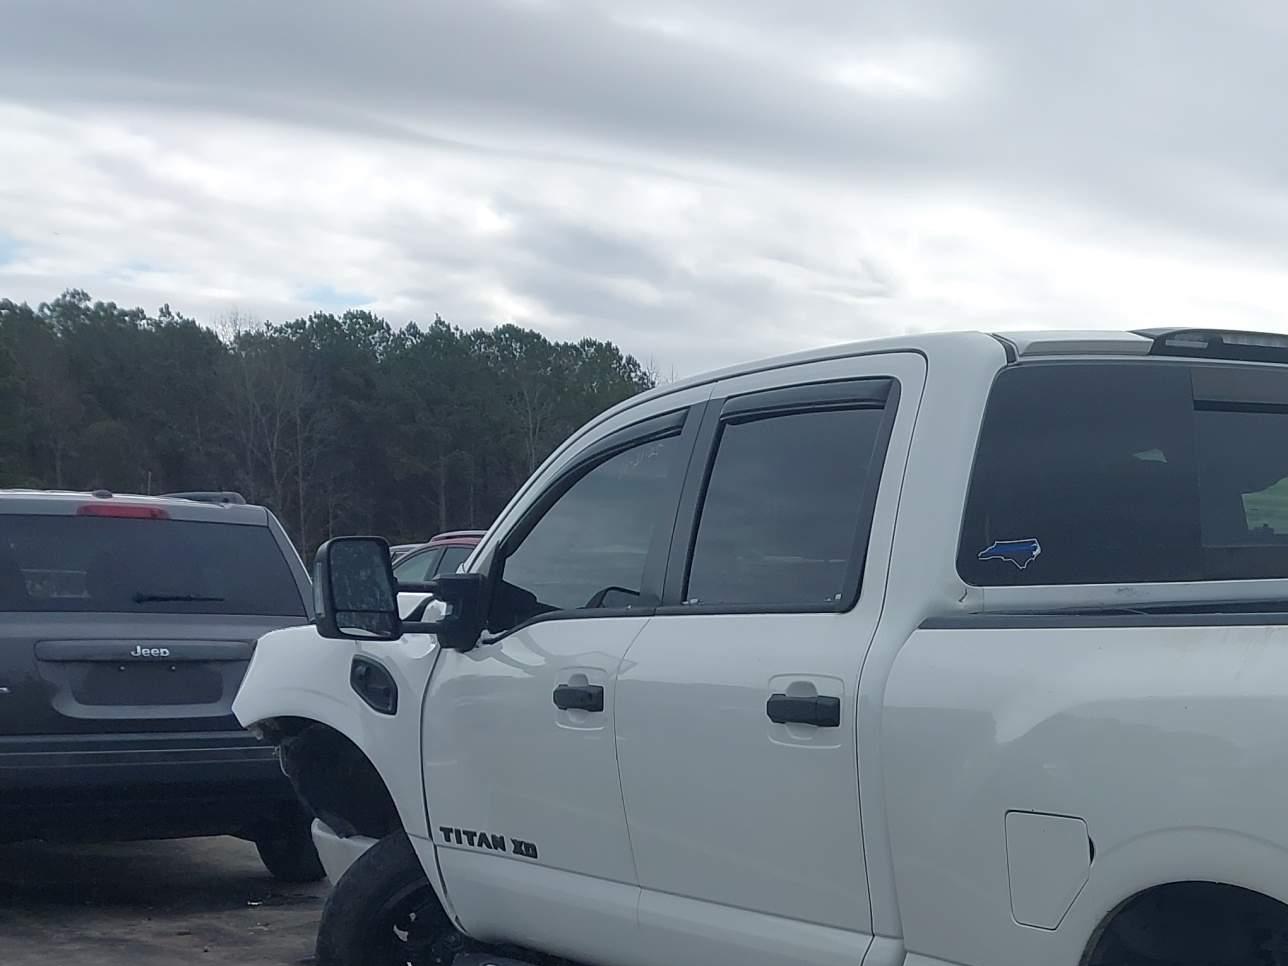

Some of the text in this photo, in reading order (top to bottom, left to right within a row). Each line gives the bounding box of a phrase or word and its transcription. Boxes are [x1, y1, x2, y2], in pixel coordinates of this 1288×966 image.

[130, 645, 170, 657] Jeep
[439, 826, 538, 859] TITAN XD
